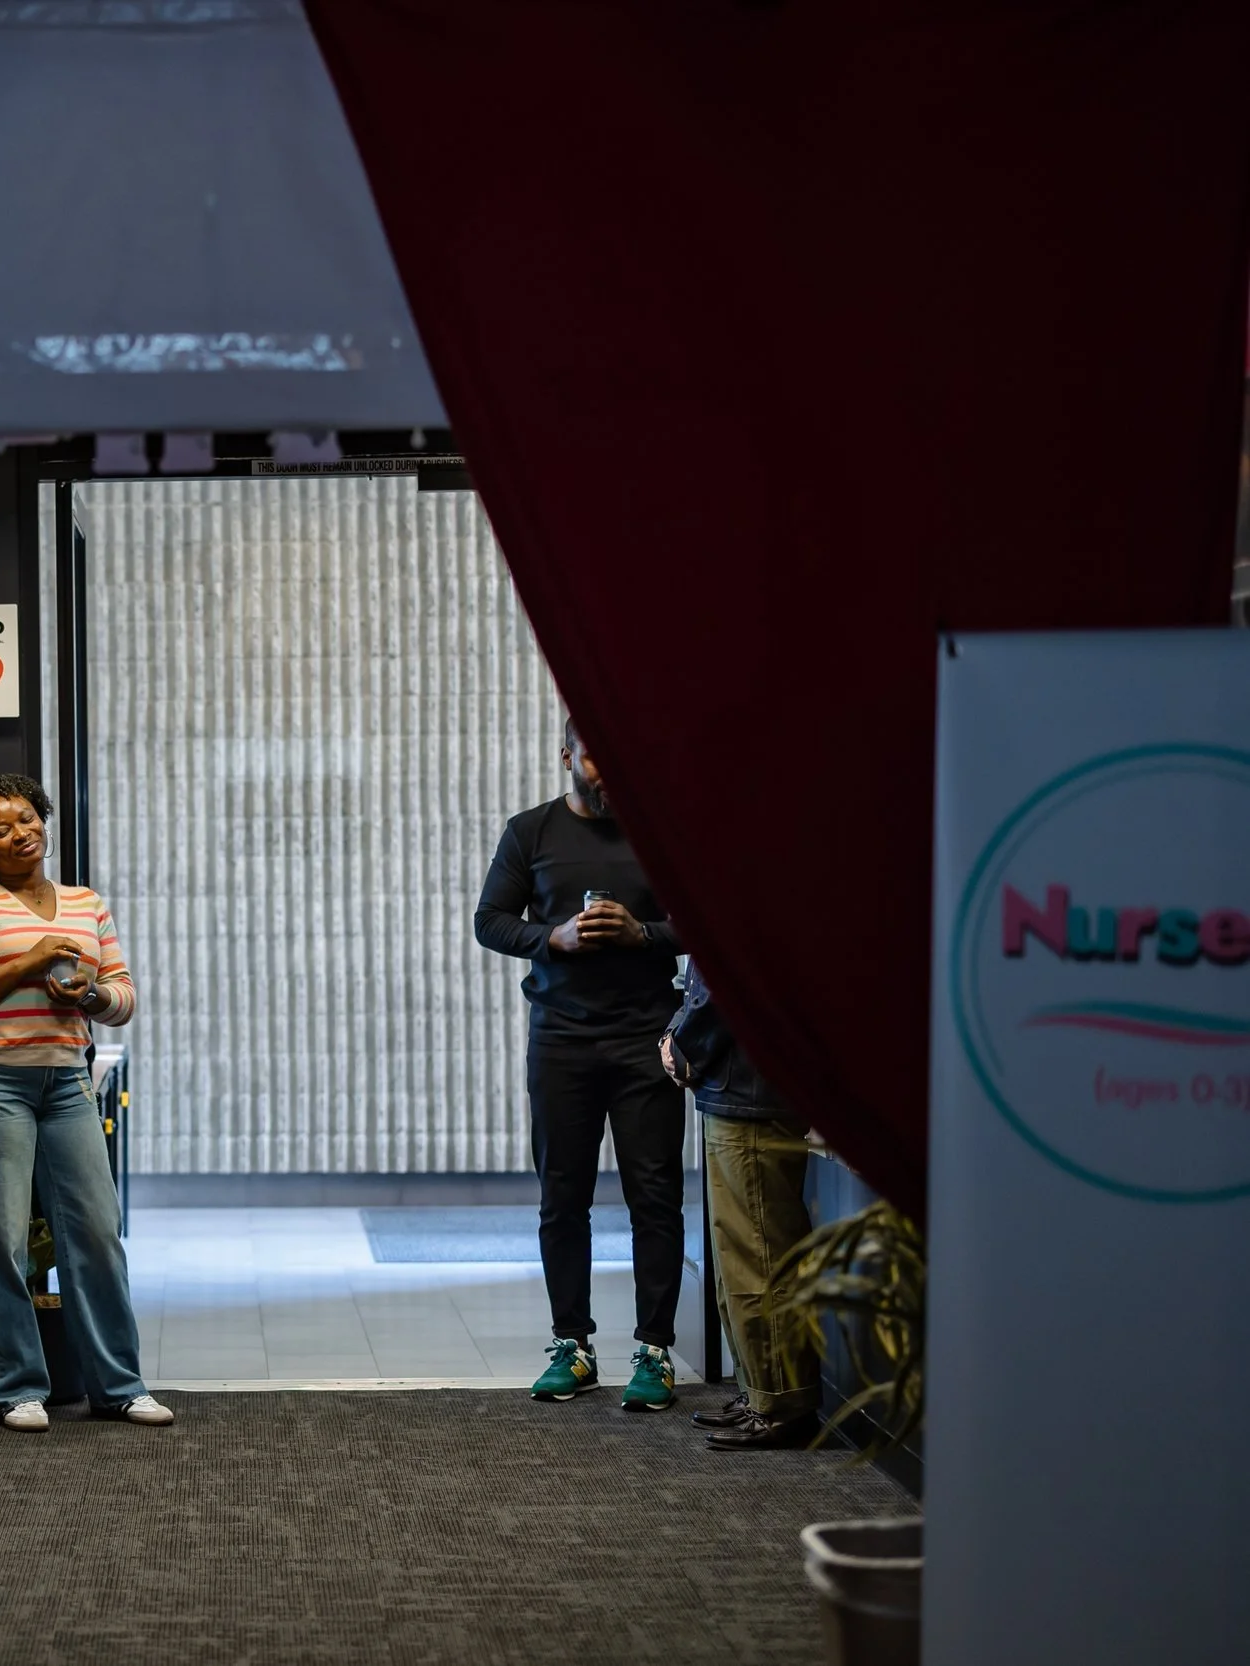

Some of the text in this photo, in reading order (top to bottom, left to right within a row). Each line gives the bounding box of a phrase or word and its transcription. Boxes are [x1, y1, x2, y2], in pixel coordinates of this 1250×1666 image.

[257, 462, 275, 473] THIS
[353, 460, 393, 472] UNLOCKED
[395, 459, 420, 471] DURIN
[1001, 882, 1250, 967] Nurse
